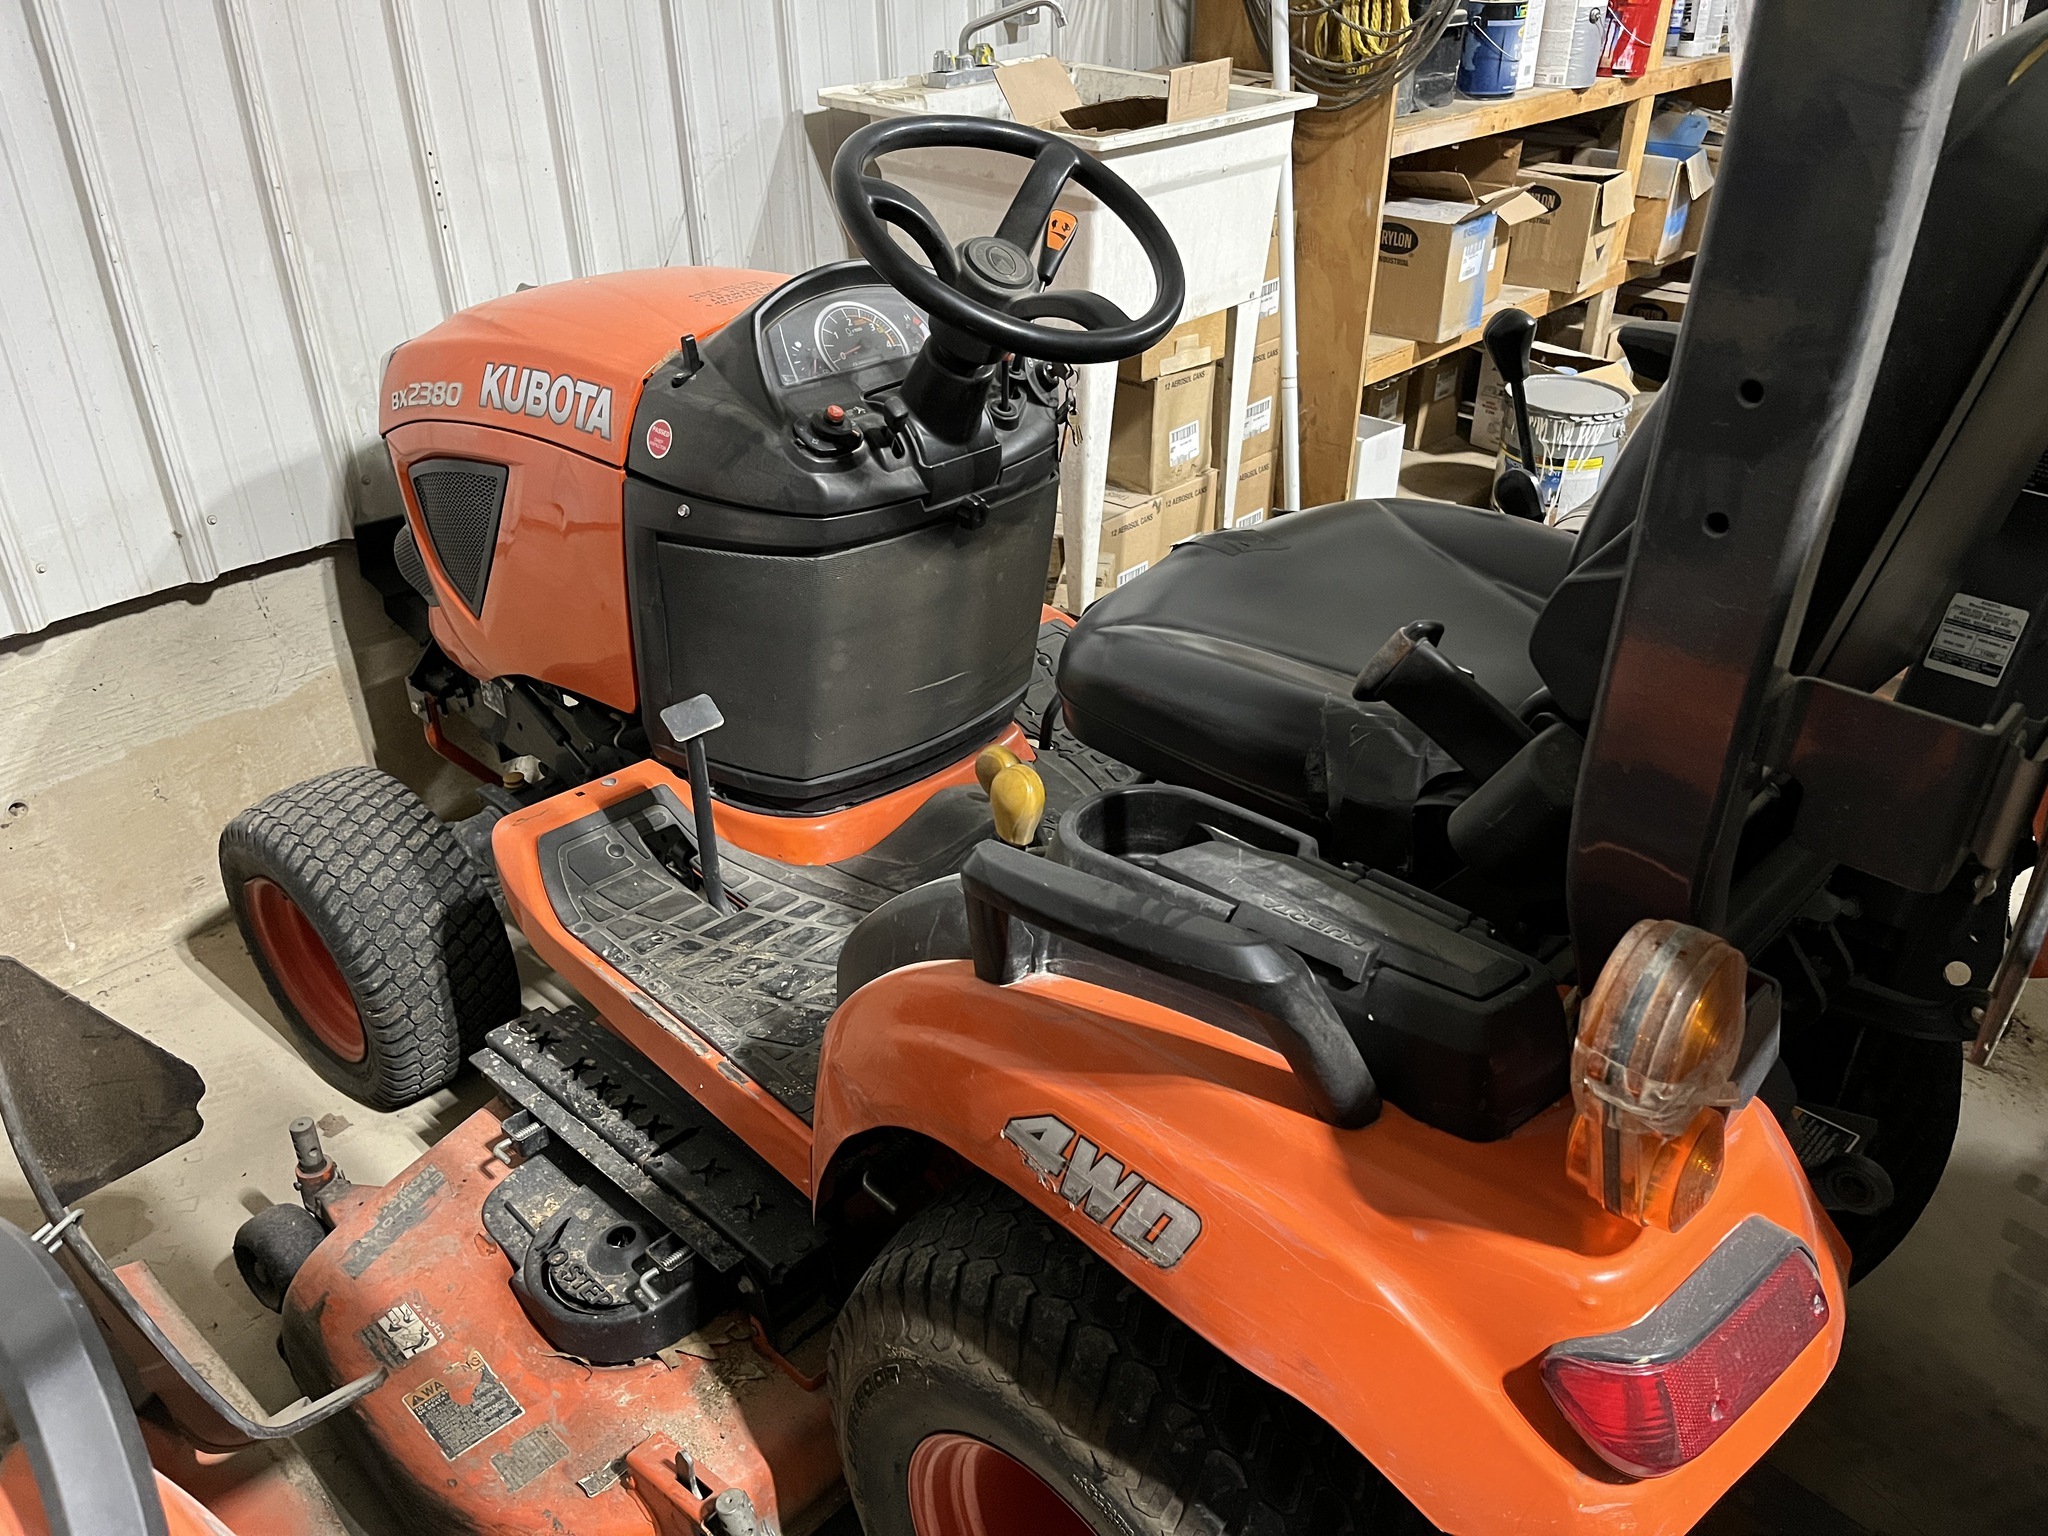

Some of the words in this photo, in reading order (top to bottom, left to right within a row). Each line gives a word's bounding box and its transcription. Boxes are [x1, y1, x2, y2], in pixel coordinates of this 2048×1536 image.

[1381, 229, 1413, 249] RYLON
[846, 318, 853, 326] 2
[868, 323, 875, 332] 3
[1171, 375, 1192, 388] AEROSOL
[1192, 370, 1206, 381] CANS
[392, 382, 463, 411] BX2380
[479, 362, 612, 442] KUBOTA
[1172, 492, 1194, 505] AEROSOL
[1194, 485, 1208, 496] CANS
[1117, 518, 1140, 536] AEROSOL
[1139, 513, 1154, 525] CANS
[1003, 1112, 1203, 1270] 4WD
[560, 1263, 615, 1307] STEP
